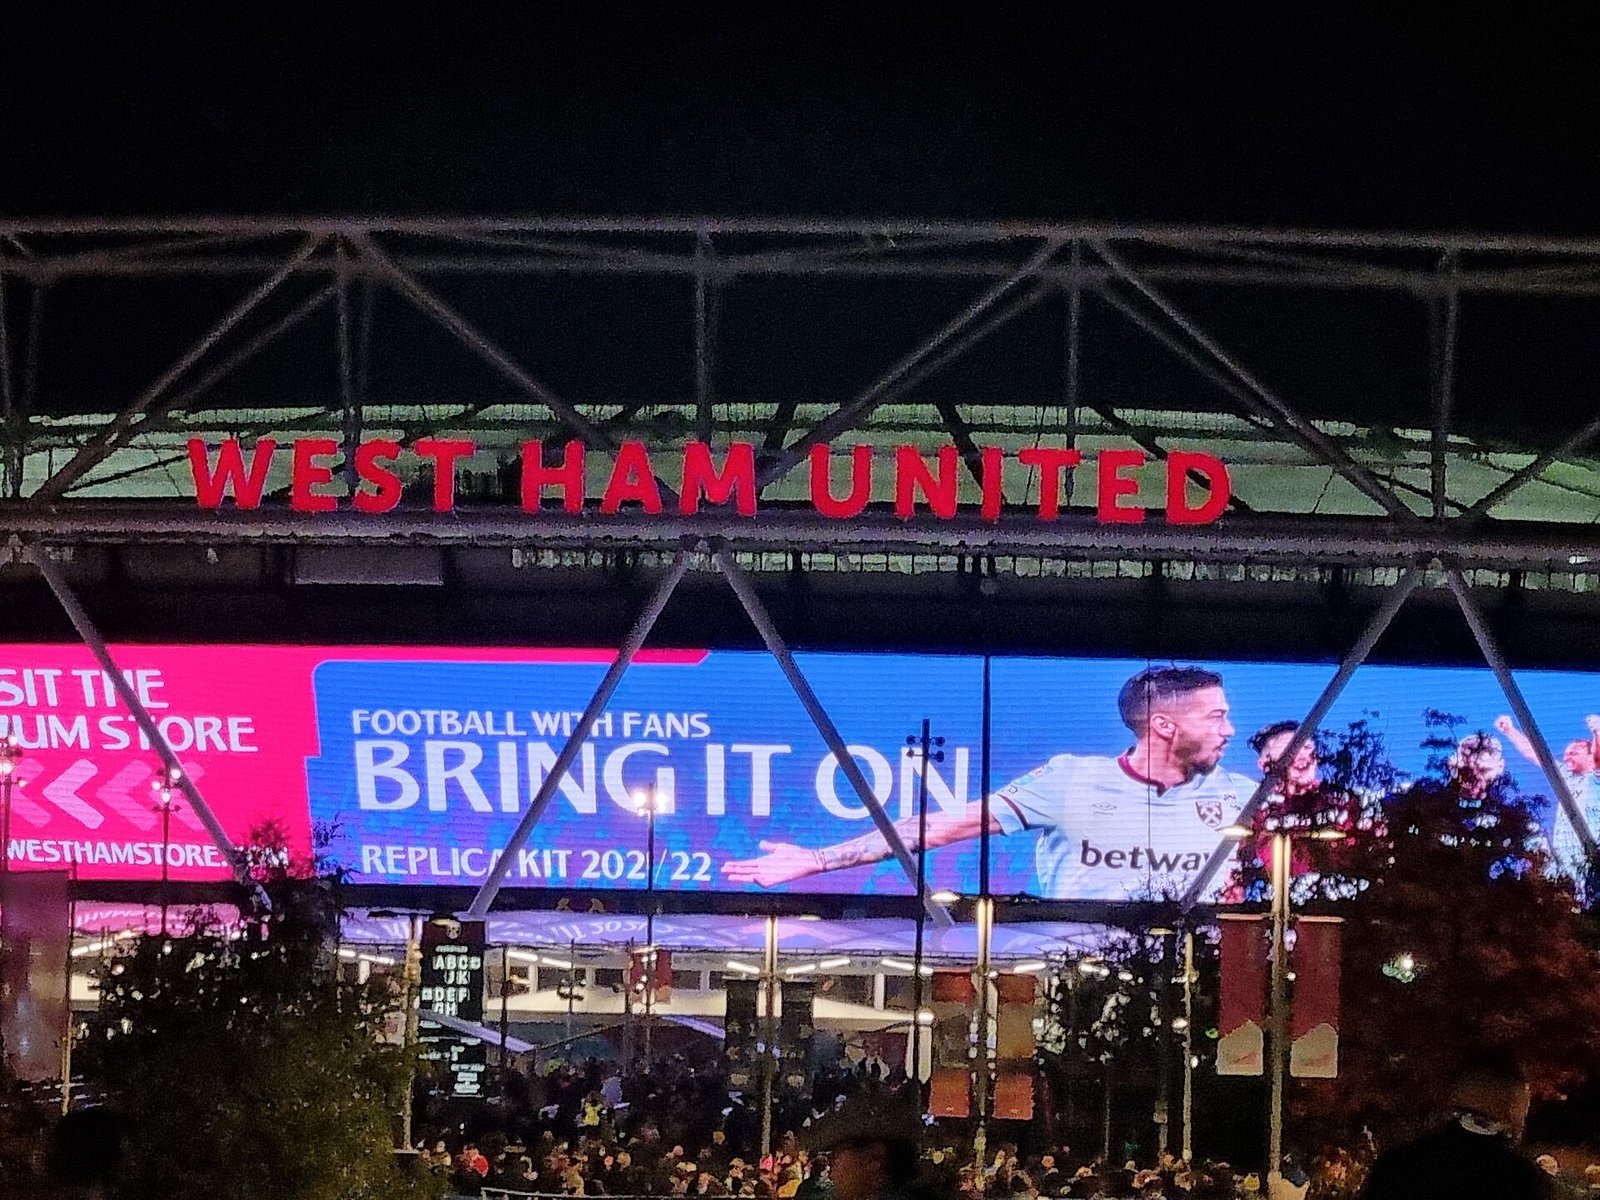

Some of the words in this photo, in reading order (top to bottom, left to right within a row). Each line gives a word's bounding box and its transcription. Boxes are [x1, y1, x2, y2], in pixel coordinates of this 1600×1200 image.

[187, 438, 475, 513] WEST
[521, 441, 757, 516] HAM
[810, 443, 1231, 525] UNITED
[0, 668, 63, 706] SIT
[352, 709, 526, 736] FOOTBALL
[623, 712, 711, 738] FANS
[354, 739, 677, 815] BRING
[706, 743, 792, 816] IT
[815, 743, 970, 820] ON
[517, 847, 573, 878] KIT
